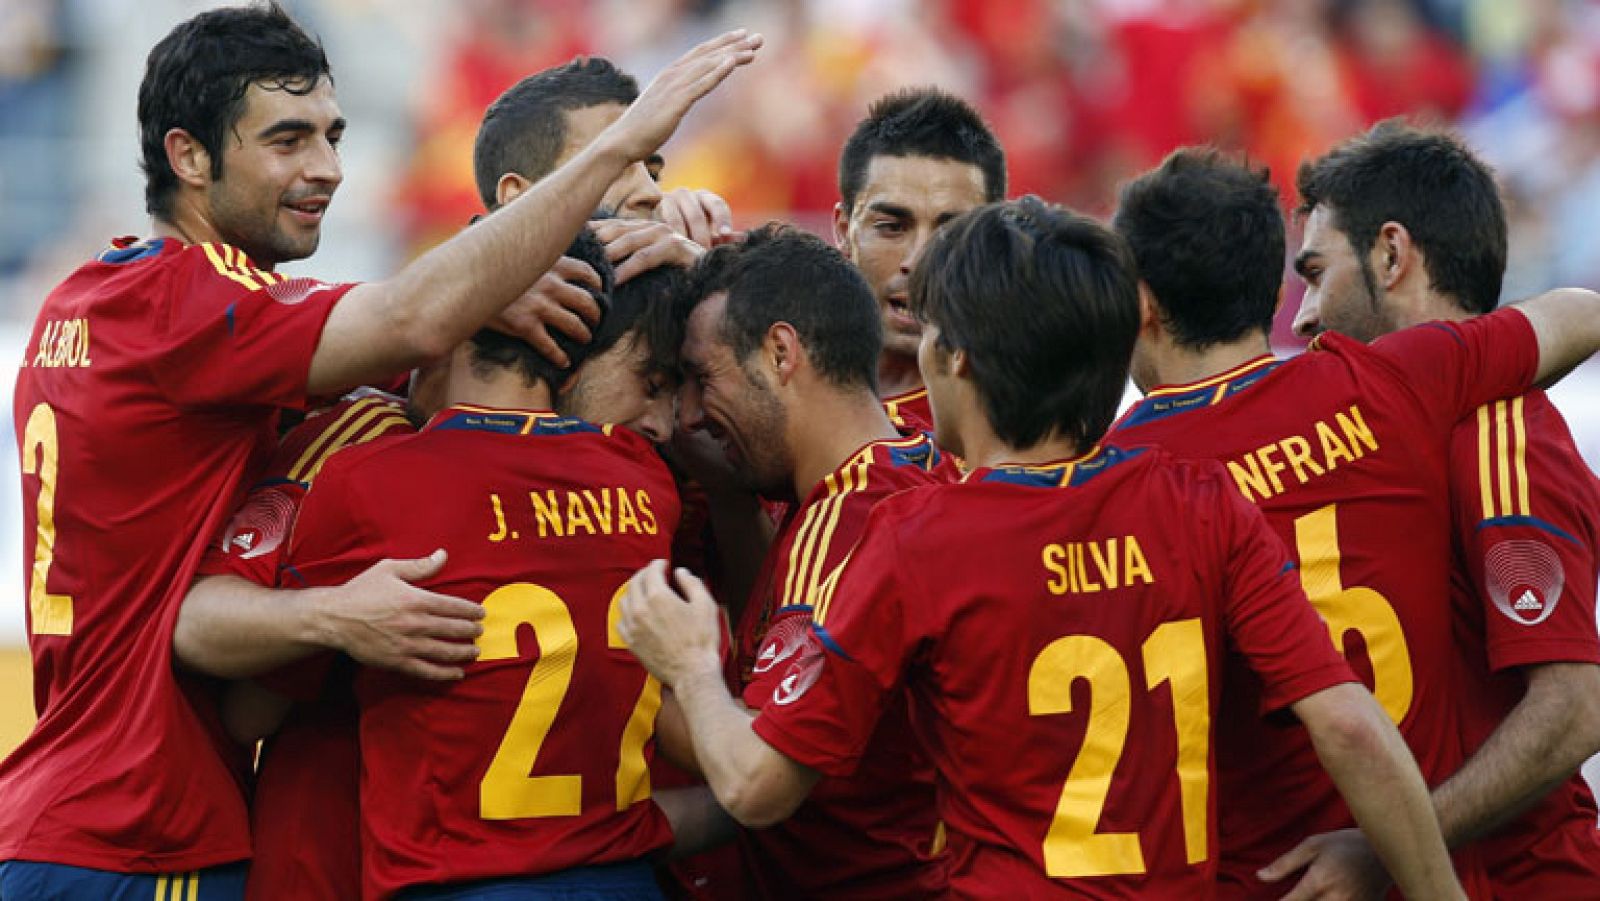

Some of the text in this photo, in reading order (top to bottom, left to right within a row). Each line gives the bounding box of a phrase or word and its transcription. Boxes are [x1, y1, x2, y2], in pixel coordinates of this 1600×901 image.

[33, 318, 92, 368] ALBIOL
[1227, 404, 1380, 502] NFRAN
[22, 402, 74, 636] 2
[487, 486, 659, 543] J. NAVAS
[1042, 536, 1155, 596] SILVA
[1293, 503, 1415, 728] 6
[1027, 617, 1211, 879] 21
